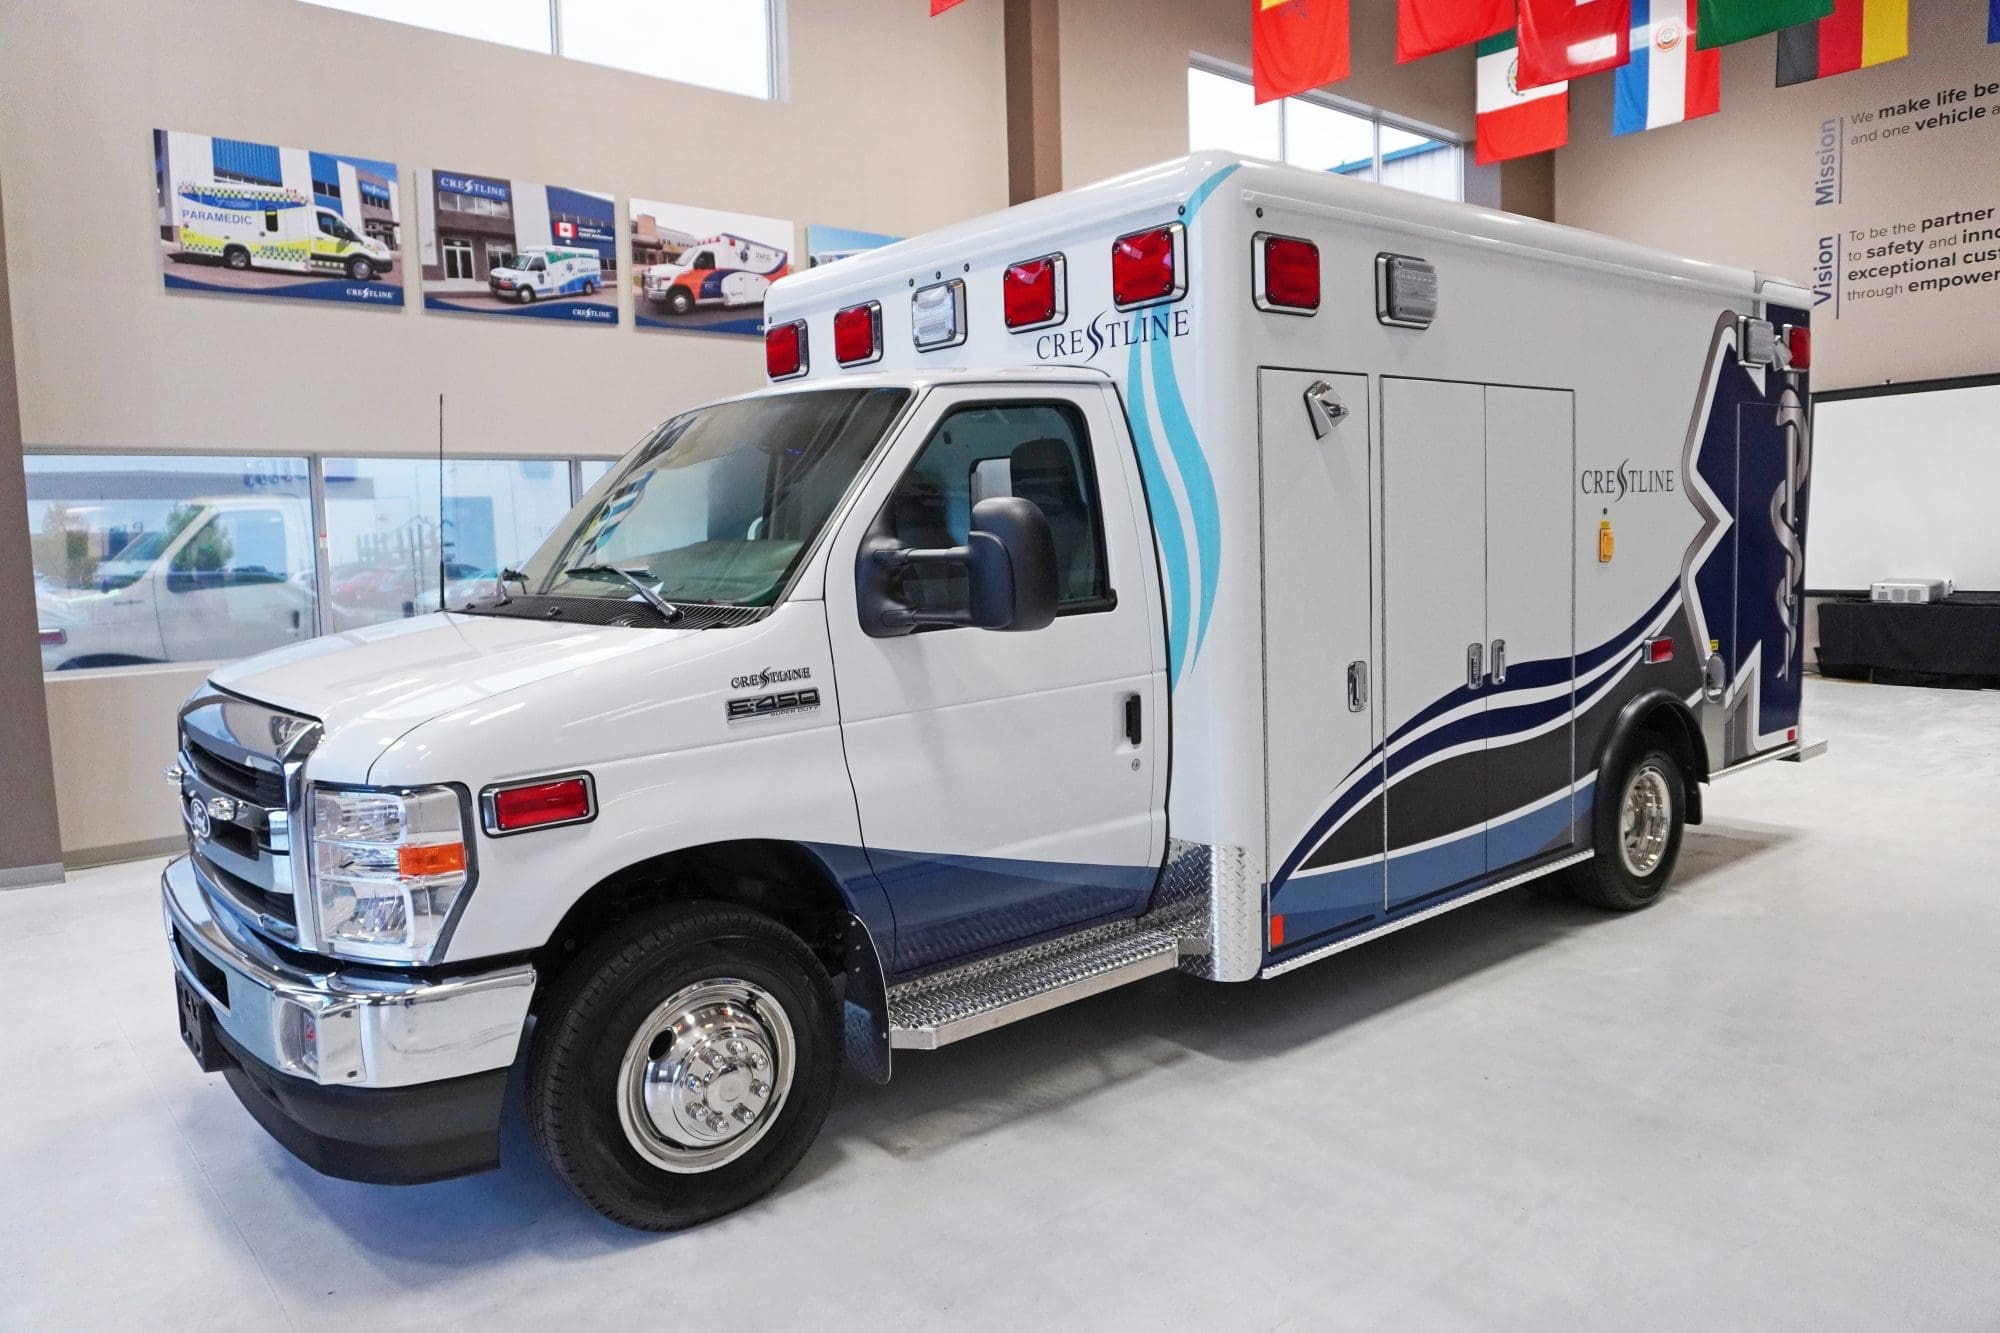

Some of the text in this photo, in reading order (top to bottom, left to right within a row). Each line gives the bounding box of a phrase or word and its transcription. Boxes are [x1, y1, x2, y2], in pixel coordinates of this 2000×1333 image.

[1850, 82, 2000, 125] We make life be
[1850, 130, 1878, 145] and
[1882, 125, 1910, 139] one
[1915, 105, 1987, 131] vehicle
[1815, 118, 1836, 206] Mission
[440, 176, 506, 197] CRESTLINE
[182, 209, 253, 225] PARAMEDIC
[1849, 207, 1995, 241] To be the partner
[1847, 252, 1862, 261] to
[1866, 240, 1924, 259] safety
[1928, 234, 1957, 249] and
[1813, 236, 1833, 306] Vision
[1847, 252, 1956, 281] exceptional
[345, 287, 393, 299] CRESTLINE
[1847, 284, 1903, 301] through
[572, 307, 611, 318] CRESTLINE
[1036, 309, 1190, 363] CRESTLINE
[1581, 457, 1675, 503] CRESTLINE
[730, 666, 812, 689] CRESTLINE
